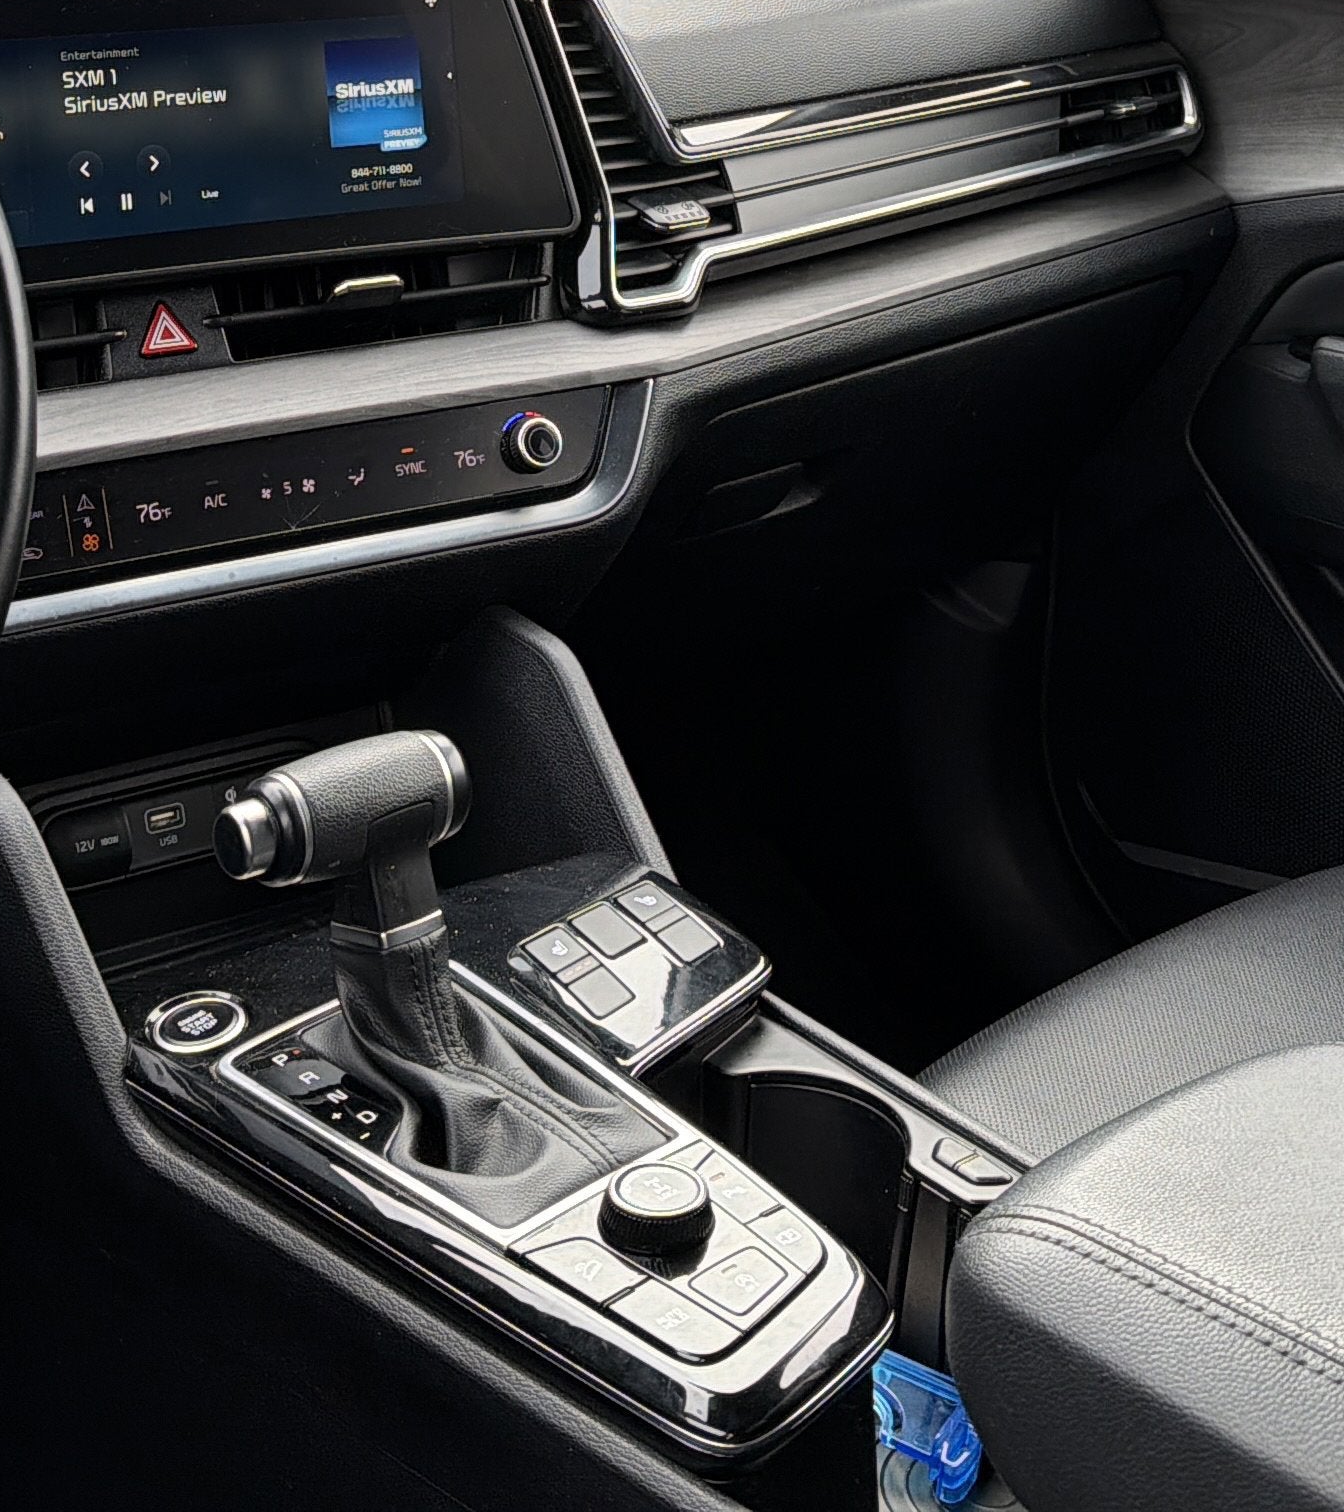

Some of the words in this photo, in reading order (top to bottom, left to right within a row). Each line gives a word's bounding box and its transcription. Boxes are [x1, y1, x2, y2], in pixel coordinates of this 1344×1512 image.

[60, 48, 140, 62] Entertainment
[62, 69, 105, 88] SXM
[109, 68, 117, 85] 1
[335, 78, 415, 99] SiriusXM
[63, 92, 149, 115] SiriusXM
[153, 88, 228, 107] Preview
[340, 180, 370, 194] Great
[371, 177, 397, 189] Offer
[399, 175, 424, 187] Now!
[394, 459, 427, 478] SYNC
[203, 492, 229, 510] A/C
[74, 838, 96, 855] 12V
[159, 834, 179, 848] USB
[180, 1012, 214, 1034] START
[190, 1018, 219, 1036] STOP
[271, 1052, 289, 1068] P
[298, 1070, 321, 1085] R
[326, 1088, 349, 1105] N
[355, 1110, 378, 1125] D
